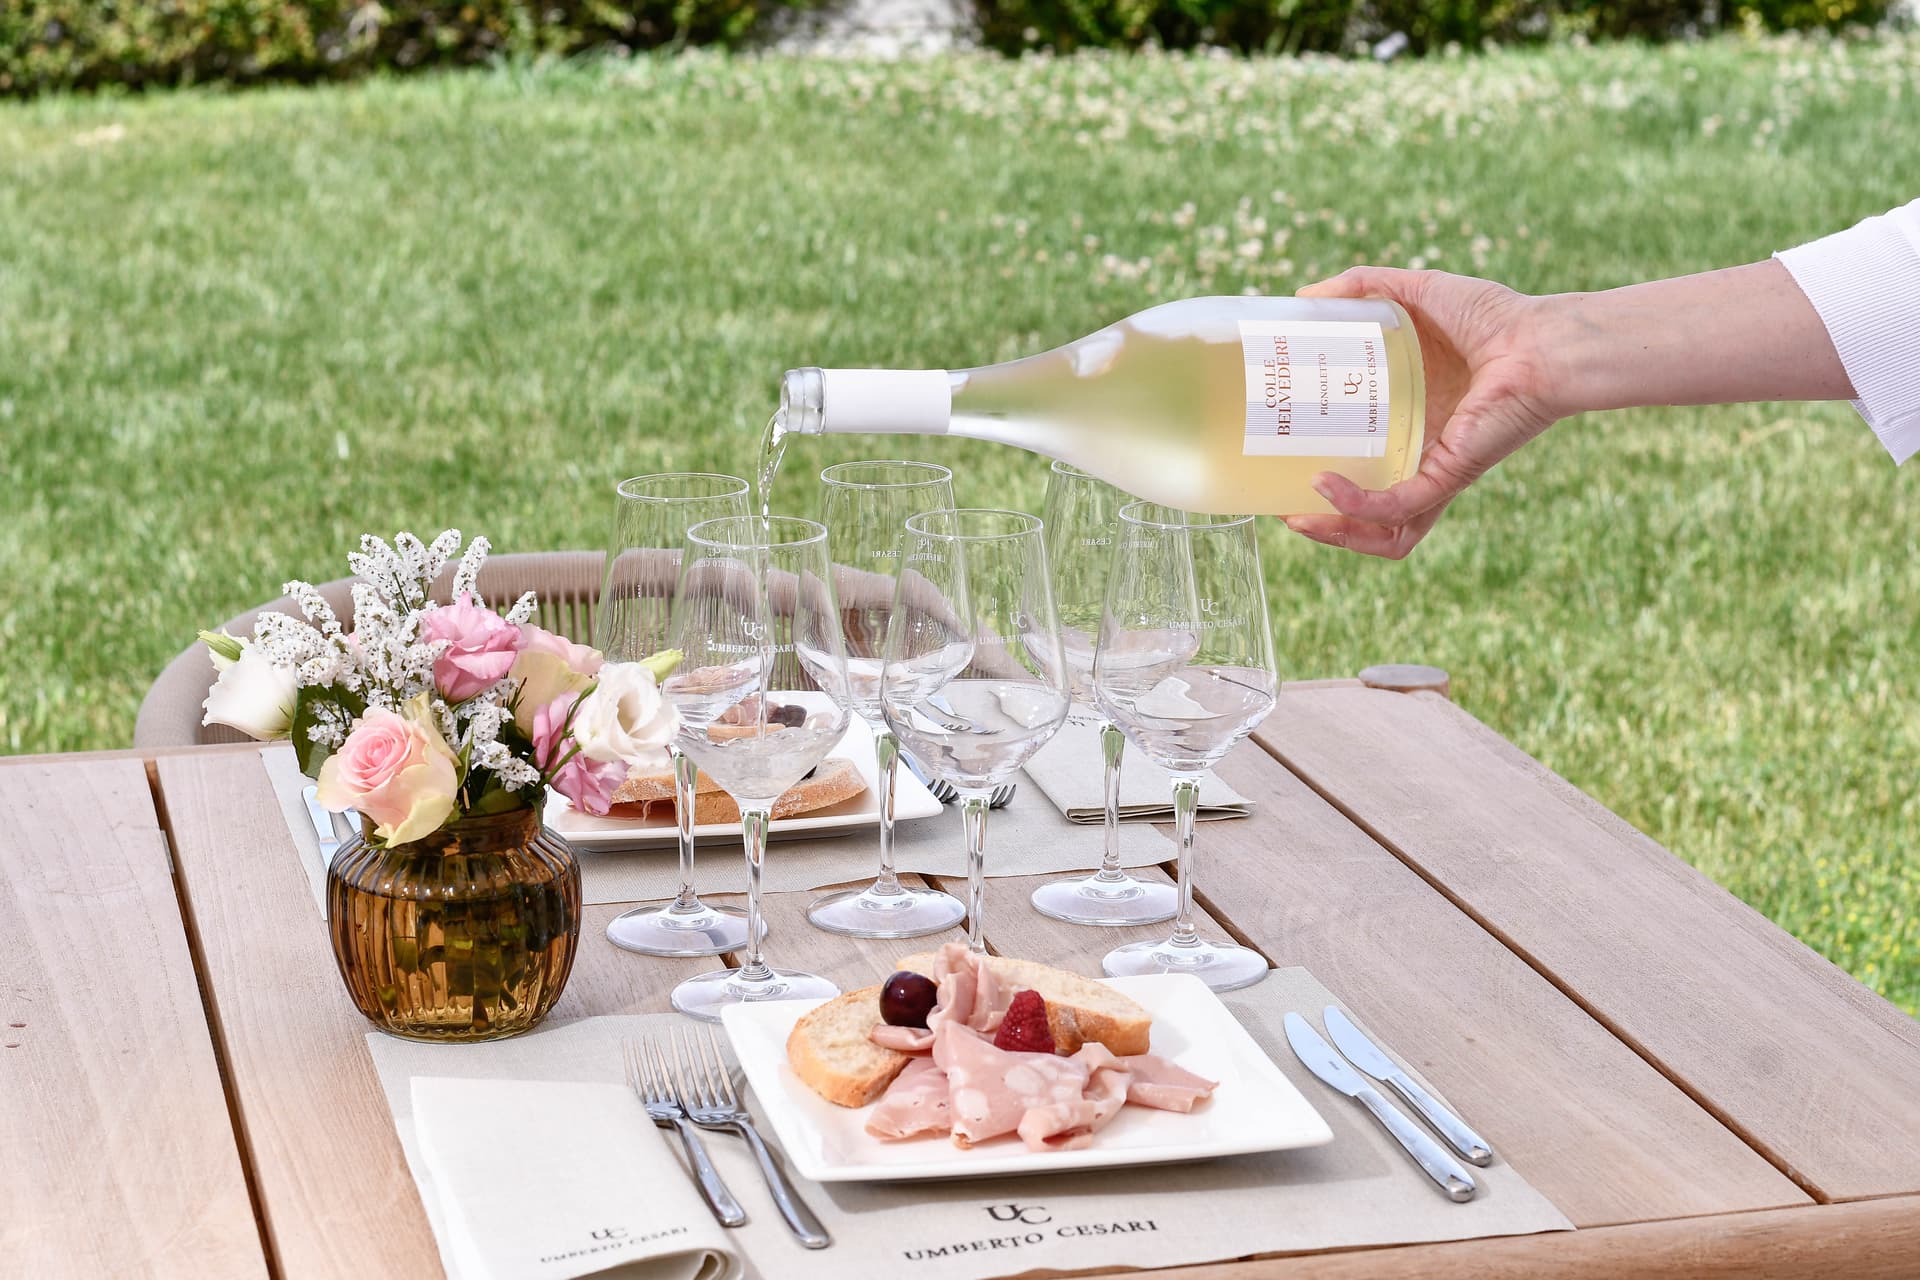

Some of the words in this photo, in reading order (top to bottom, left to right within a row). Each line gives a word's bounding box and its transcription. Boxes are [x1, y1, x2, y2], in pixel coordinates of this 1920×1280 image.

[1365, 340, 1377, 375] CESARI
[1264, 359, 1277, 408] COLLE
[1274, 335, 1291, 435] BELVEDERE
[1318, 353, 1328, 415] PIGNOLETTO
[1368, 380, 1377, 432] UMBERTO
[712, 643, 757, 653] UMBERTO
[540, 1242, 622, 1263] UMBERTO
[629, 1226, 688, 1245] CESARI
[904, 1232, 1044, 1261] UMBERTO
[1056, 1220, 1159, 1238] CESARI
